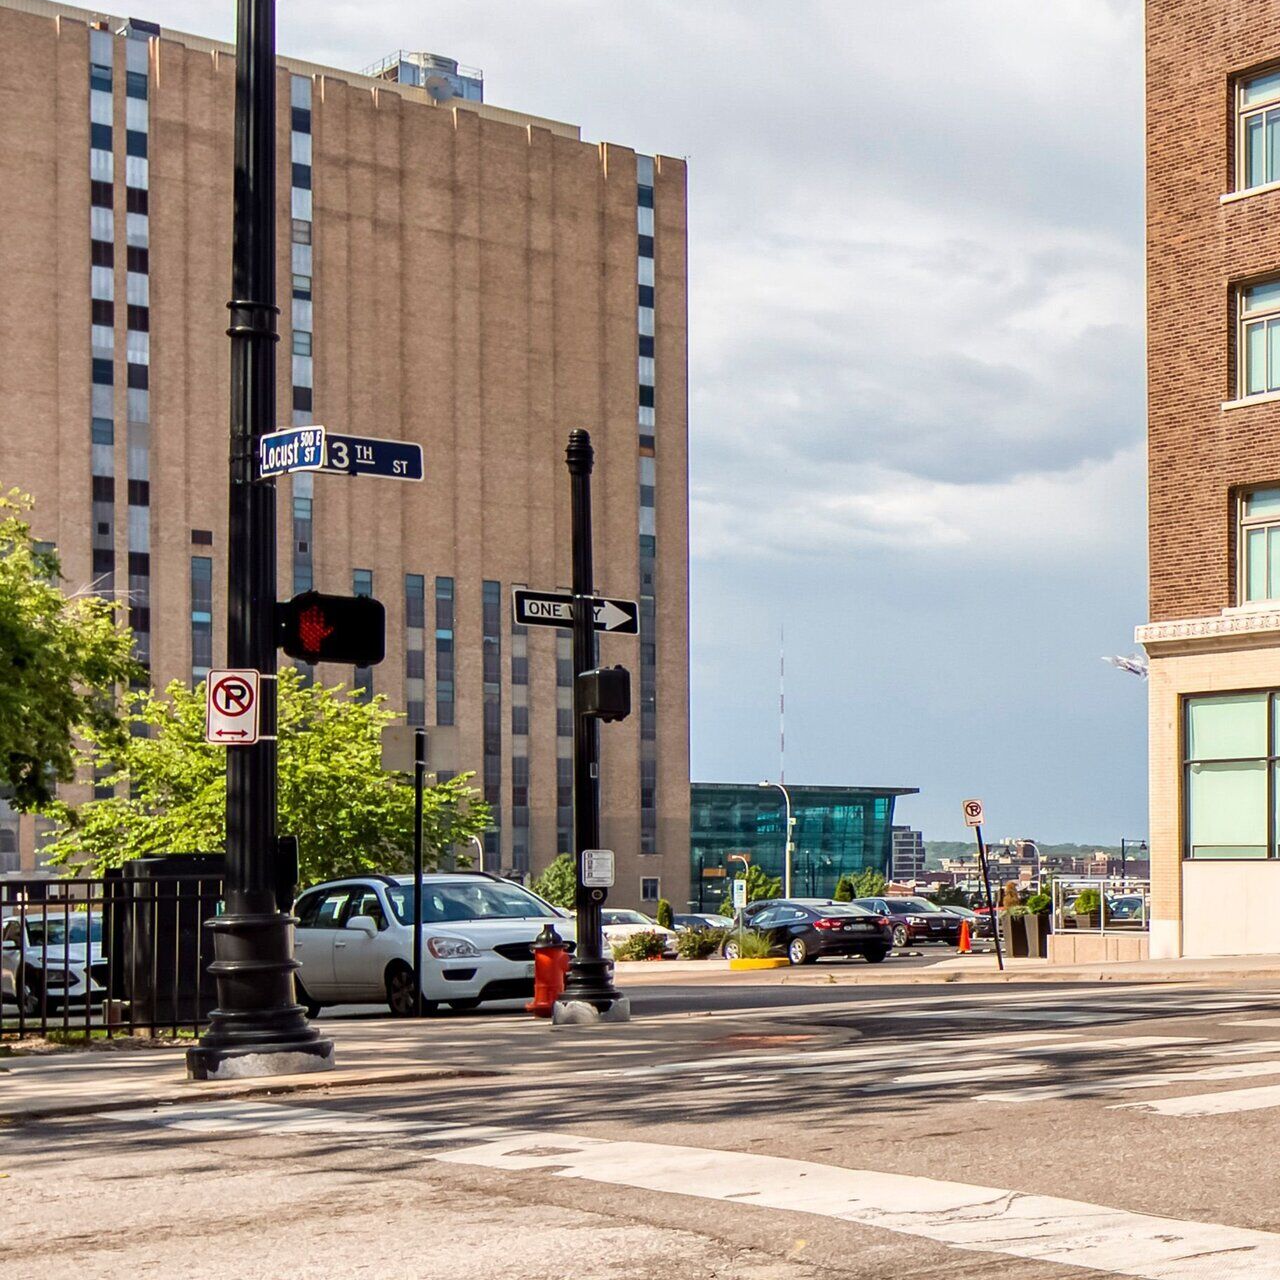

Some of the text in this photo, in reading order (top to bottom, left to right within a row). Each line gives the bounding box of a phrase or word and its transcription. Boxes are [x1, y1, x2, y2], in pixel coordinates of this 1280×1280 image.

[300, 430, 321, 448] 500 E
[262, 437, 316, 470] Locust ST
[392, 459, 408, 474] ST
[528, 601, 562, 617] ONE
